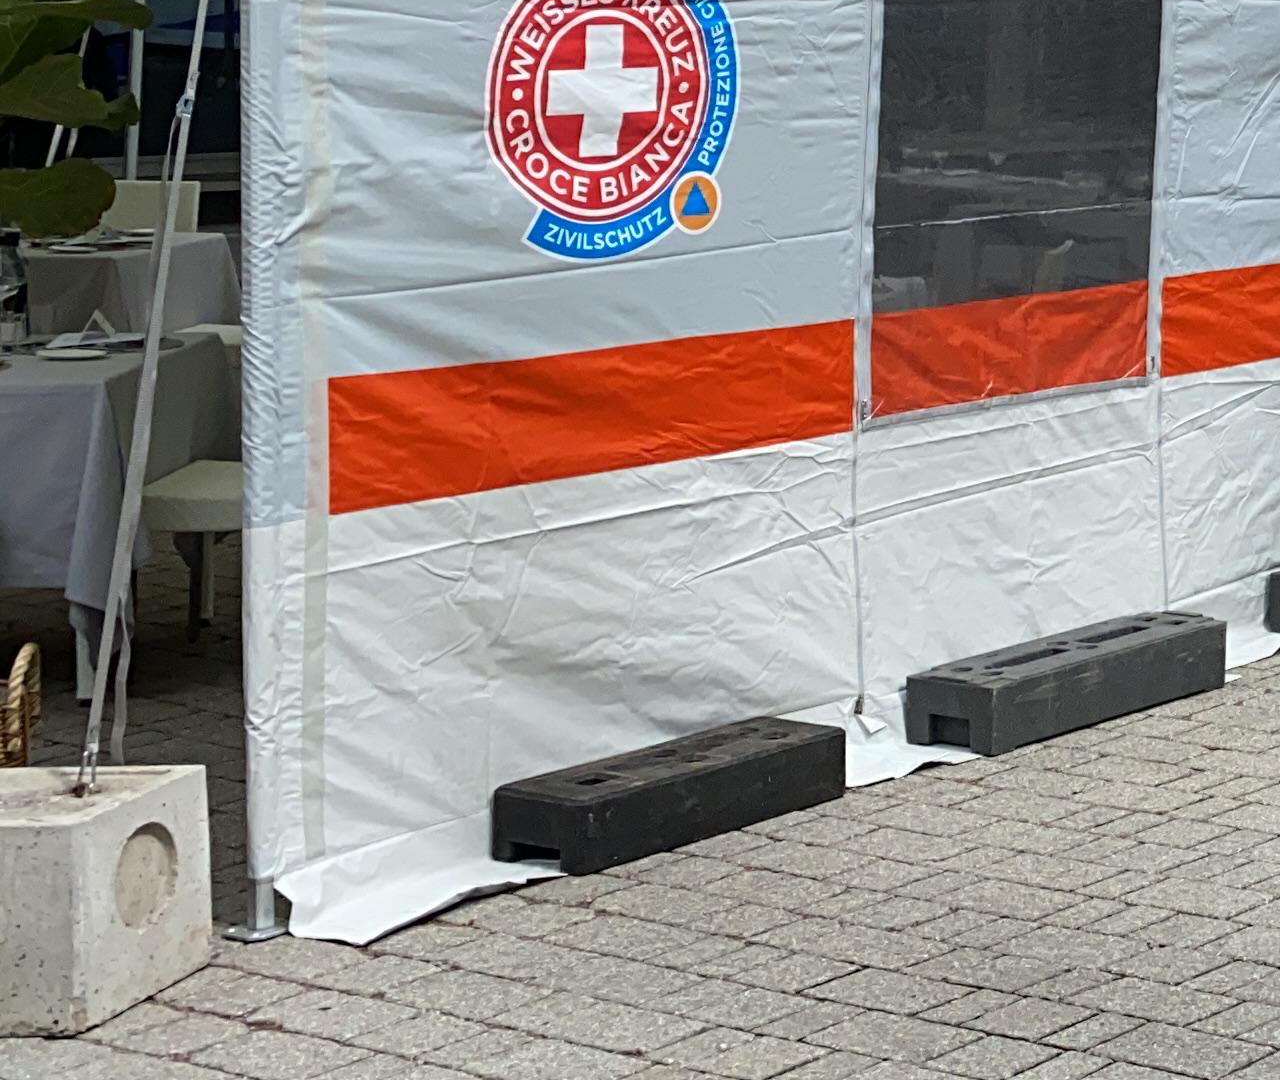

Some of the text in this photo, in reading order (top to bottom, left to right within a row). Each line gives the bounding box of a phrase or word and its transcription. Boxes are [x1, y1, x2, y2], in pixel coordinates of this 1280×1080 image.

[697, 21, 730, 166] PROTEZIONE
[505, 100, 694, 204] CROCE BIANCA
[543, 206, 667, 250] ZIVILSCHUTZ
